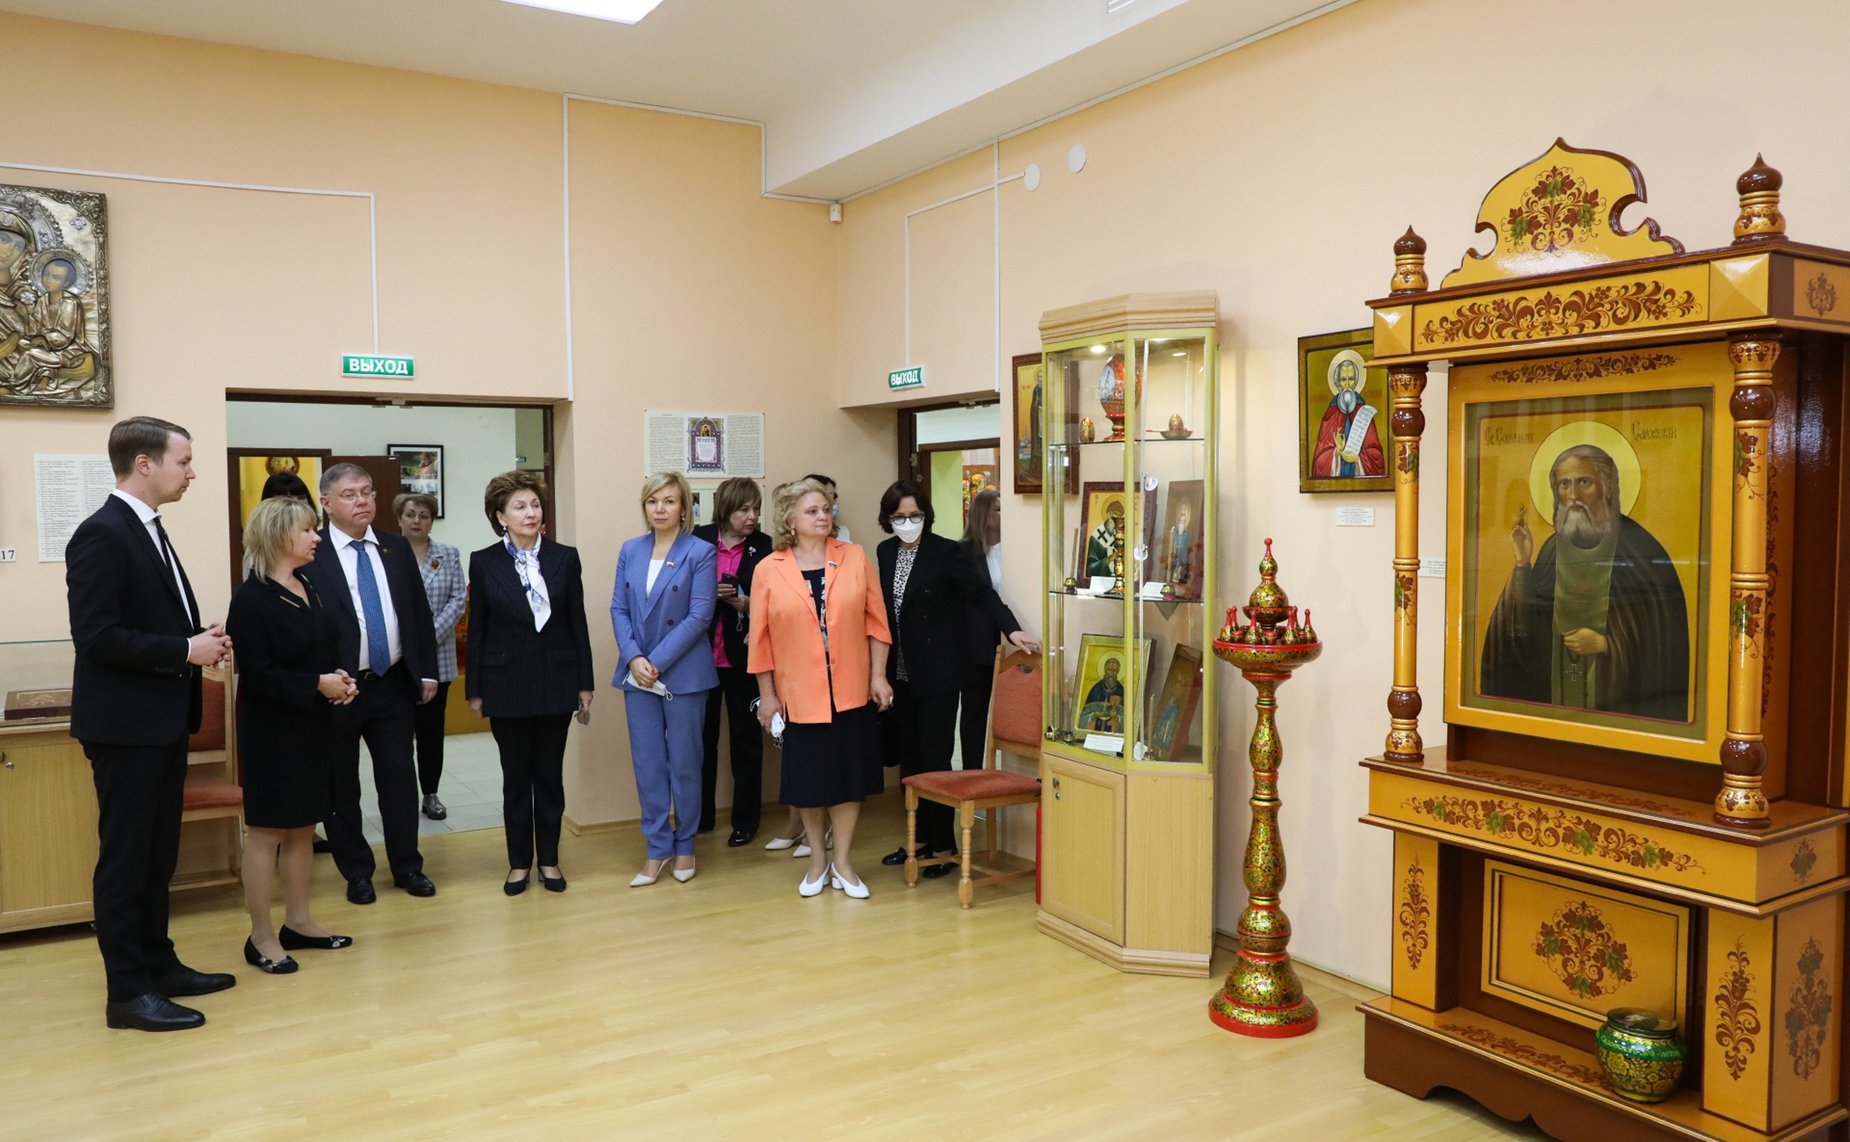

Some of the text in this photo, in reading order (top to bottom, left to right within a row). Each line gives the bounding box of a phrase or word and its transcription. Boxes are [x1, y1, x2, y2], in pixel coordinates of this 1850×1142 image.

[349, 358, 408, 375] ВЫХОД
[890, 370, 919, 386] ВЫХОД
[1, 549, 15, 560] 17
